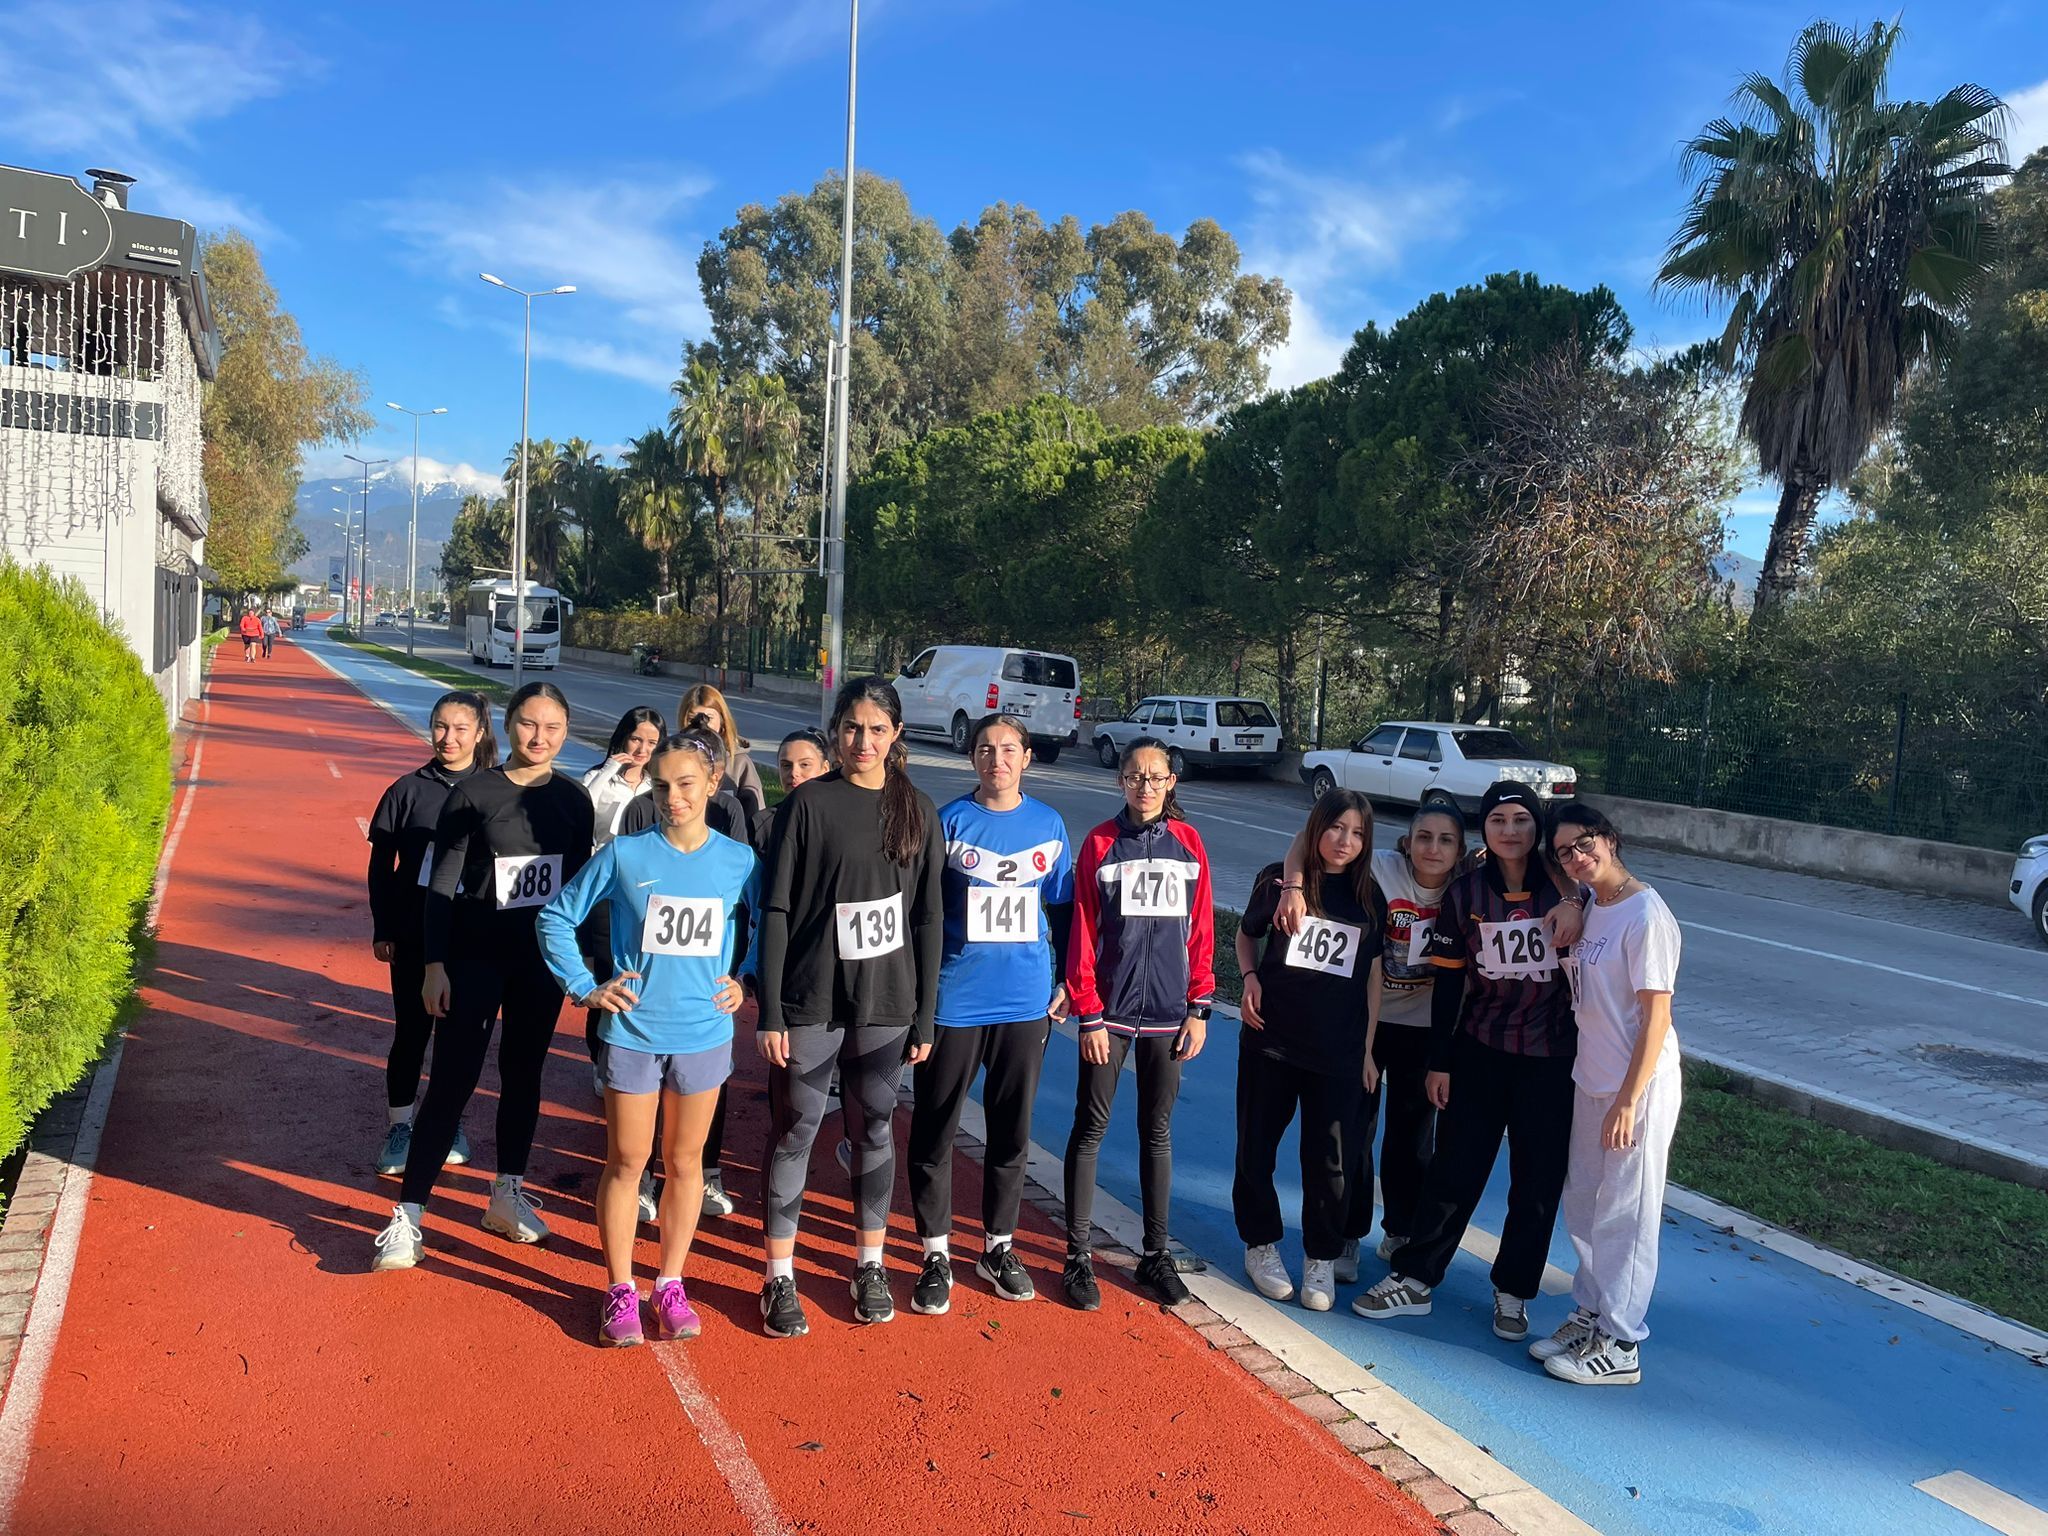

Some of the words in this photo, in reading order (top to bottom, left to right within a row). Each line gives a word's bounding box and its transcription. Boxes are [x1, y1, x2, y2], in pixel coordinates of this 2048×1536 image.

[131, 242, 156, 252] since
[507, 862, 552, 900] 388
[996, 859, 1018, 882] 2
[1131, 871, 1179, 907] 476
[655, 905, 713, 947] 304
[849, 905, 896, 950] 139
[980, 896, 1026, 933] 141
[1297, 925, 1348, 967] 462
[1492, 927, 1546, 964] 126
